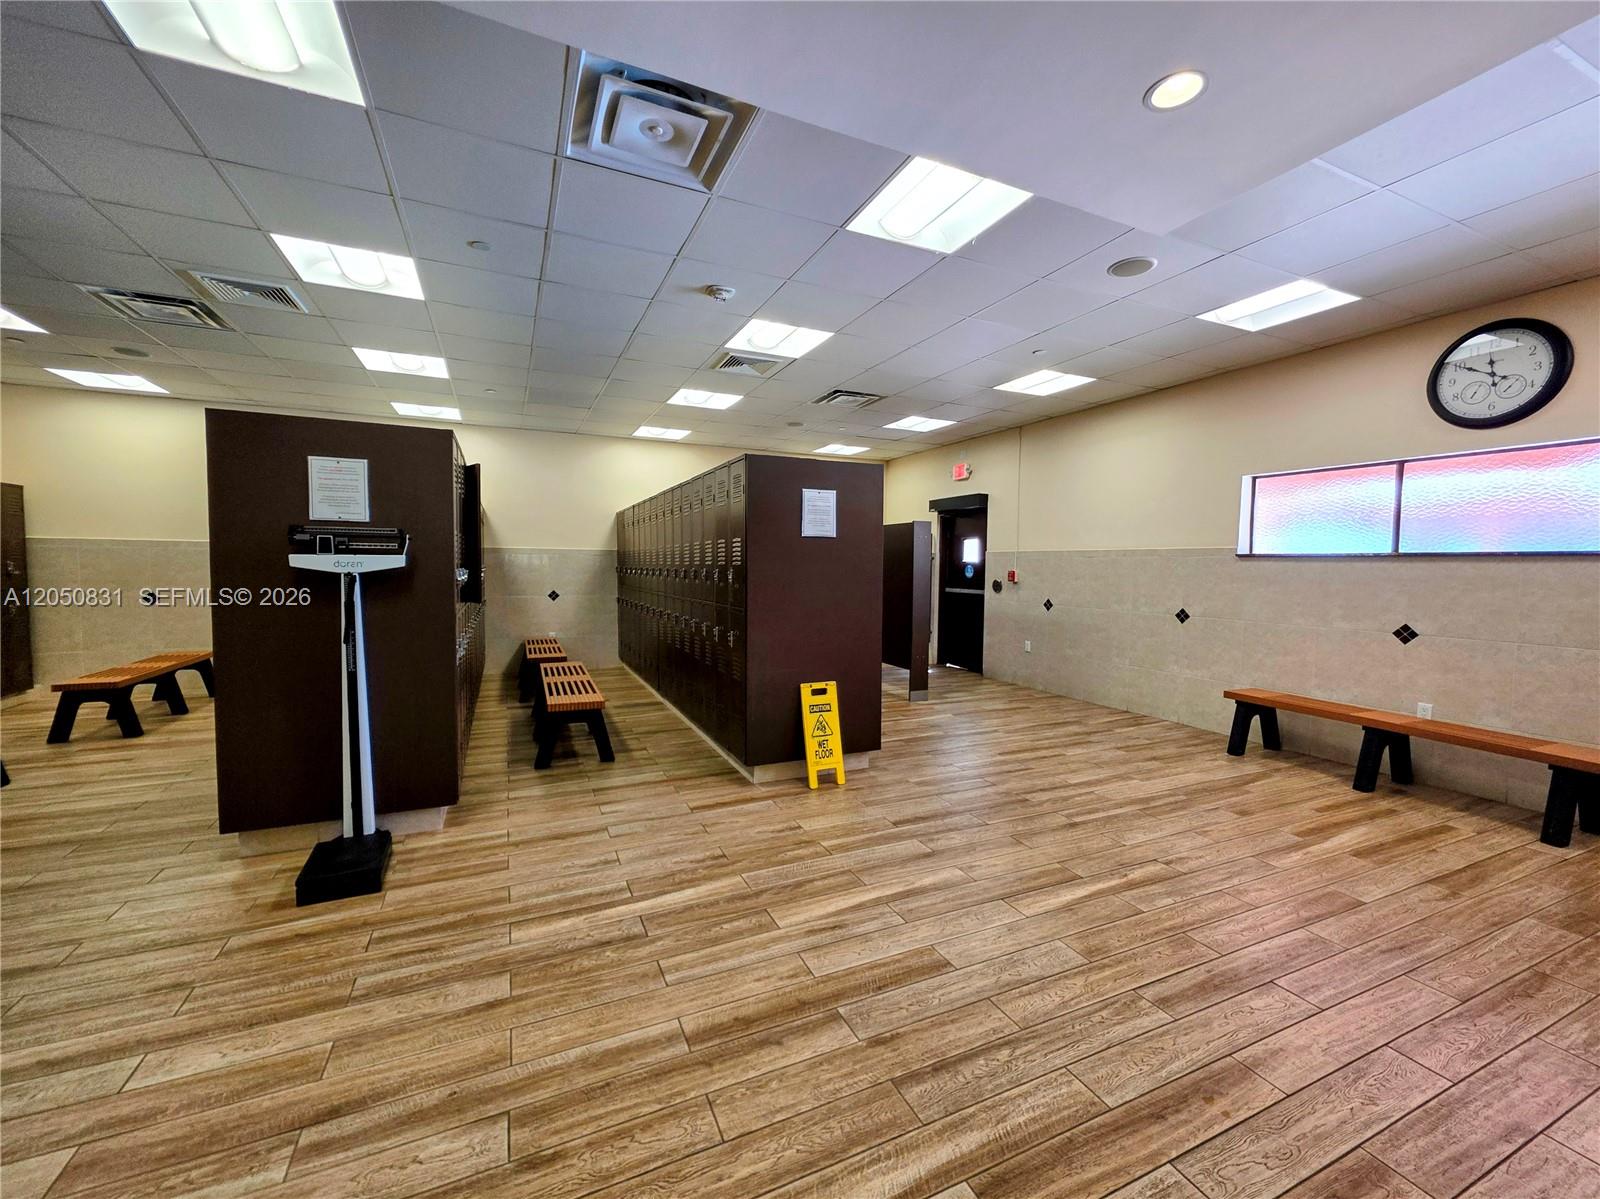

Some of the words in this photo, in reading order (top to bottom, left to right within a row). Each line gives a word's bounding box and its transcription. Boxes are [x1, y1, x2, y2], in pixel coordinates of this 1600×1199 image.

[1528, 345, 1537, 357] 2
[1453, 361, 1466, 373] 10
[1534, 361, 1543, 371] 3
[1448, 379, 1456, 388] 9
[1452, 392, 1460, 402] 8
[1488, 401, 1496, 411] 6
[333, 560, 363, 568] doran
[810, 704, 830, 712] CAUTION
[816, 739, 830, 749] WET
[815, 749, 834, 760] FLOOR
